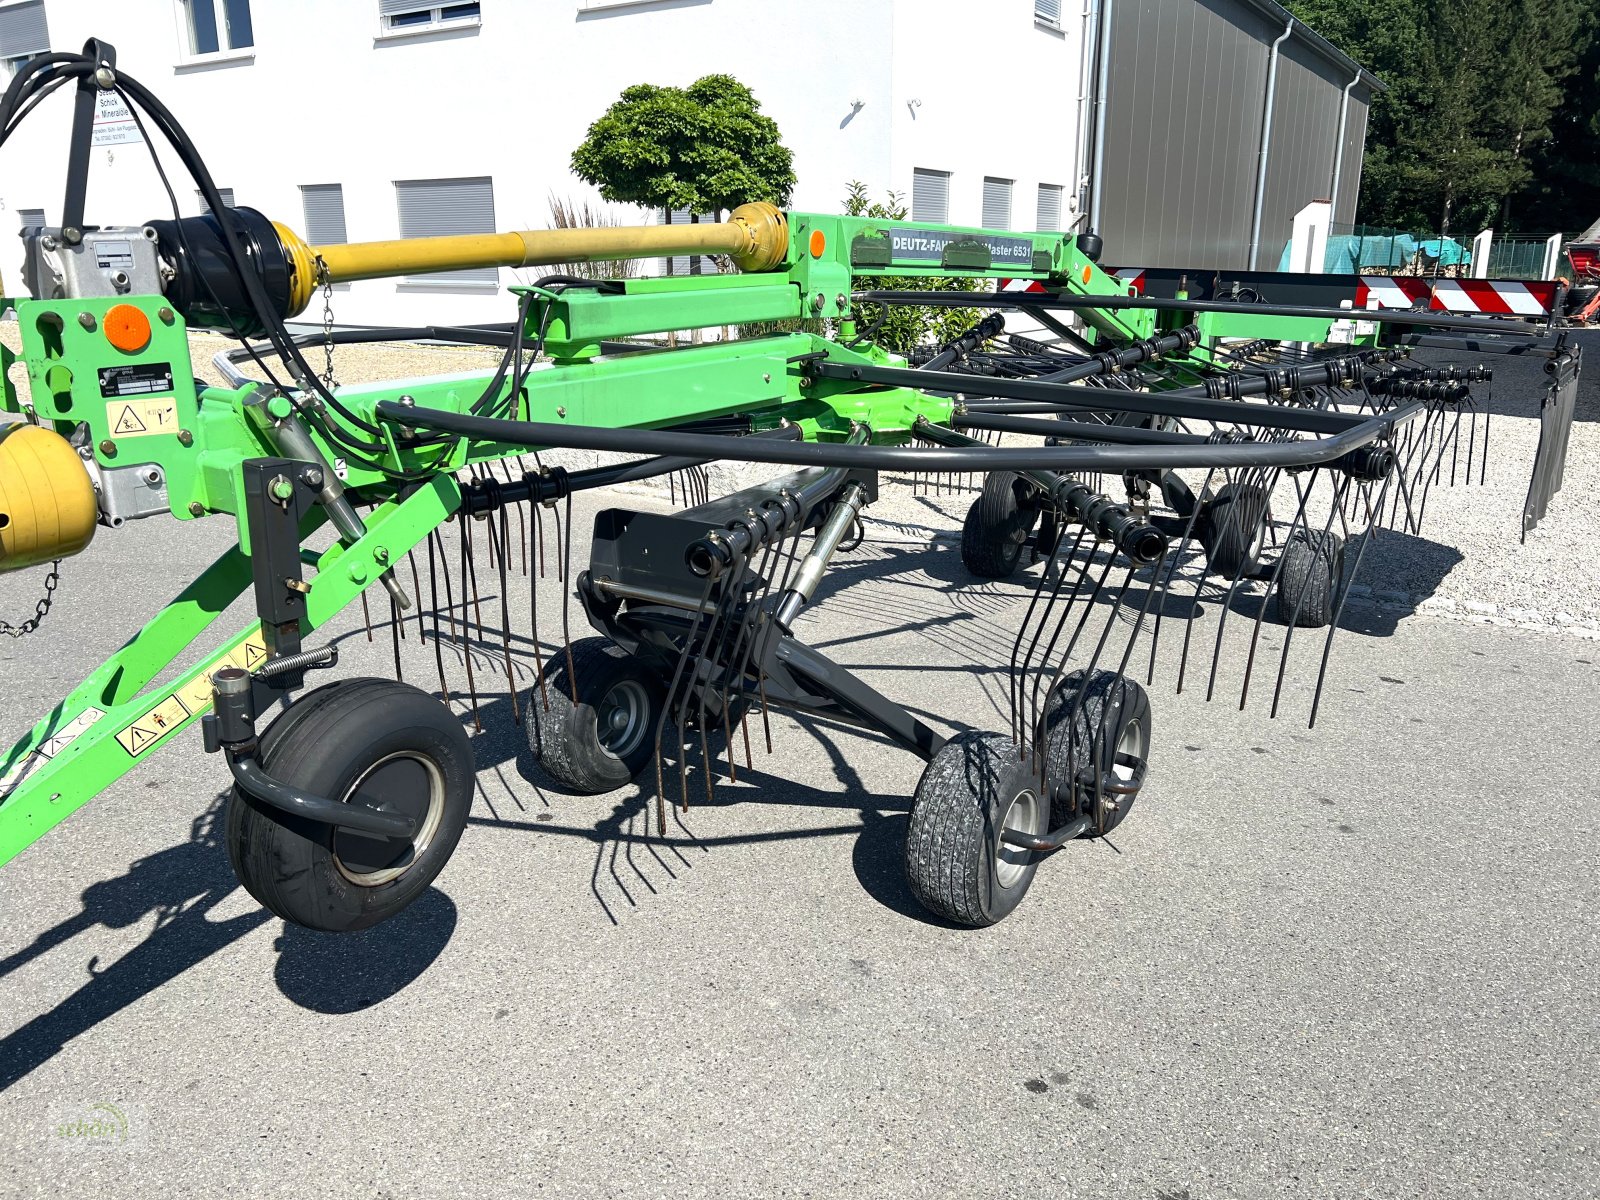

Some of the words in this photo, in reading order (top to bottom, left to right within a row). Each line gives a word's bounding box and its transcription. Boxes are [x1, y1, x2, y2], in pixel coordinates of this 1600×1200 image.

[100, 98, 118, 107] Schick
[101, 108, 129, 118] Mineralöle
[892, 236, 955, 252] DEUTZ-FAH
[981, 242, 1012, 256] Master
[1013, 245, 1031, 257] 6531
